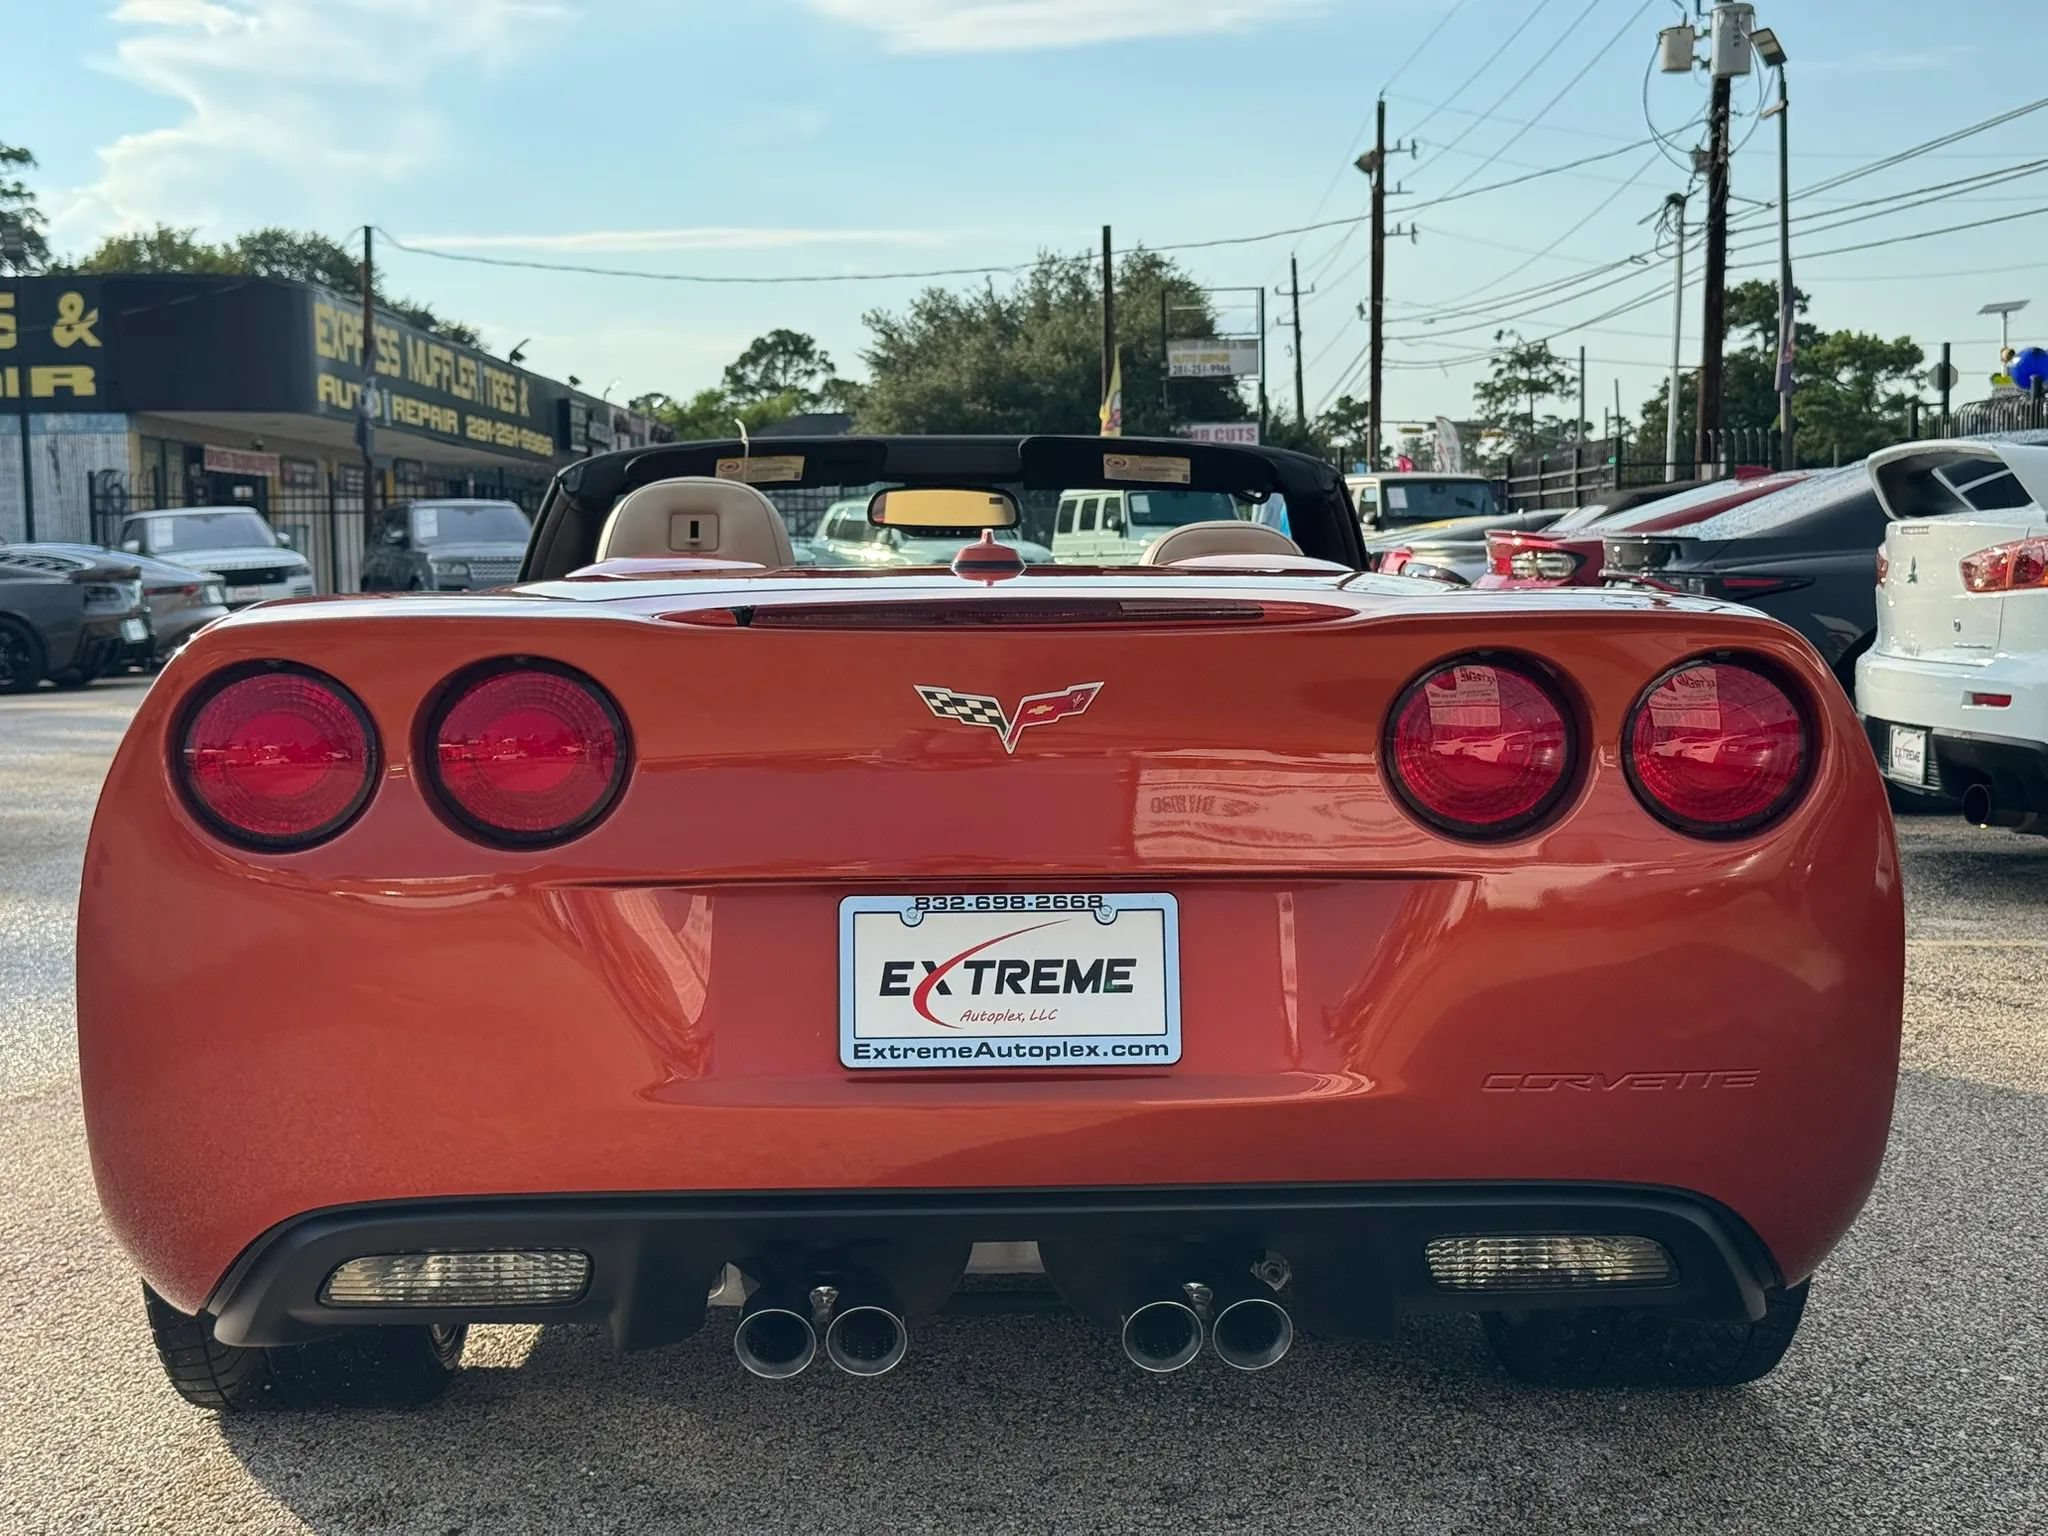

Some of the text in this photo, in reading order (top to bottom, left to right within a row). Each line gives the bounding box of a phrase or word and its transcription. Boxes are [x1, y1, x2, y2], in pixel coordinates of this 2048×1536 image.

[52, 290, 103, 349] &
[314, 303, 400, 378] EXPRSS
[406, 333, 478, 401] MUFFLER
[483, 363, 516, 414] TIRES
[391, 394, 459, 436] REPAIR
[1214, 427, 1256, 442] CUTS
[914, 895, 1104, 911] 832-698-2668
[878, 957, 1137, 998] EXTREME
[959, 1008, 1059, 1026] Autoplex, LLC
[852, 1042, 1170, 1060] ExtremeAutoplex.com
[1481, 1070, 1761, 1093] CORVETTE
